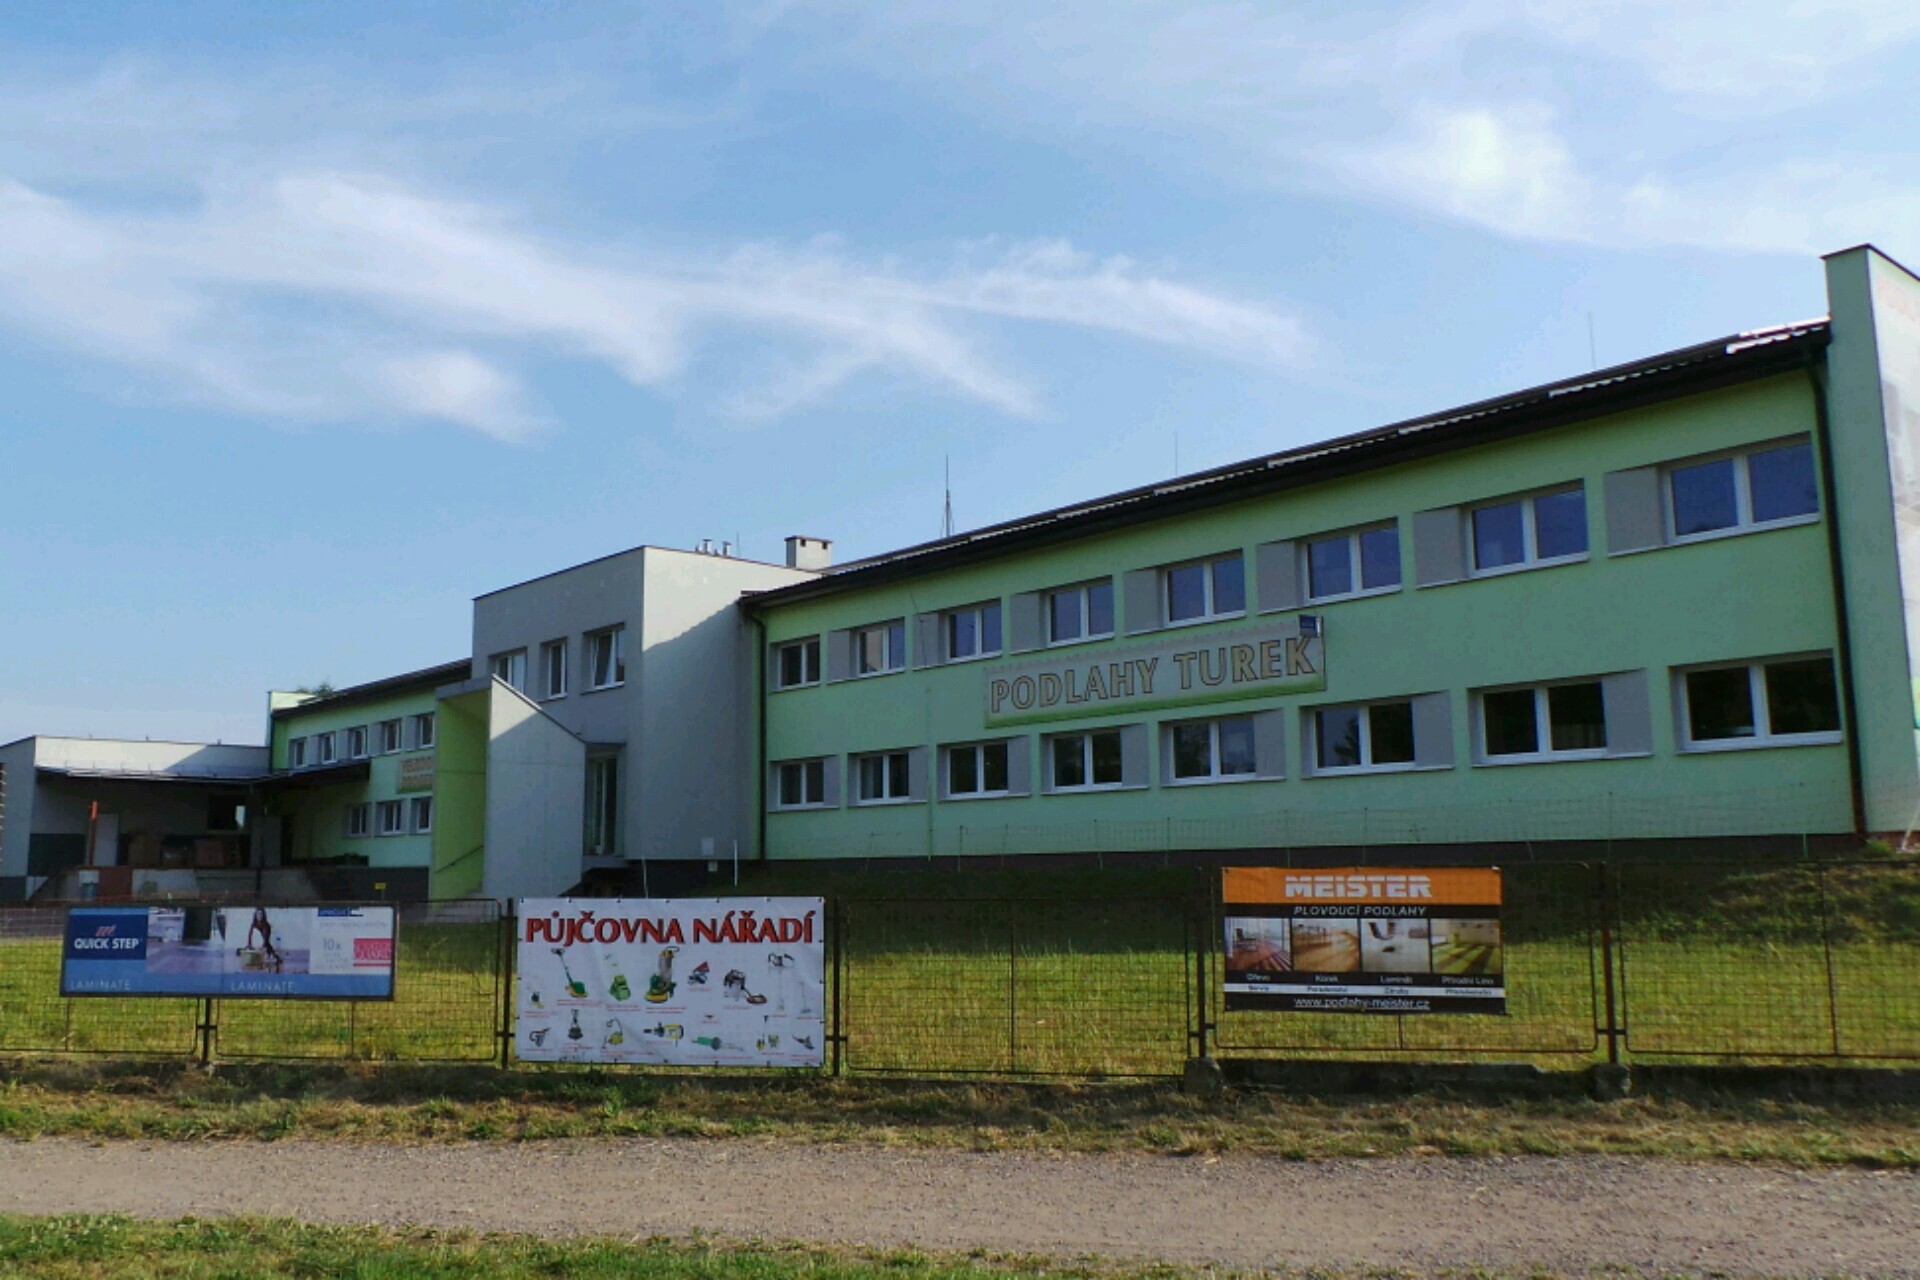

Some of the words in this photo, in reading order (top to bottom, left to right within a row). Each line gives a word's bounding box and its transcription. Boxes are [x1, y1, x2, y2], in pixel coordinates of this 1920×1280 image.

[991, 657, 1158, 713] PODLAHY
[1173, 636, 1316, 690] TUREK
[1285, 875, 1432, 898] MEISTER
[1364, 906, 1427, 916] PODLAHY
[526, 911, 685, 947] PŮJČOVNA
[693, 910, 816, 944] NÁŘADÍ
[74, 938, 109, 949] QUICK
[112, 938, 139, 949] STEP
[70, 980, 131, 990] LAMINATE
[230, 981, 295, 992] LAMINATE
